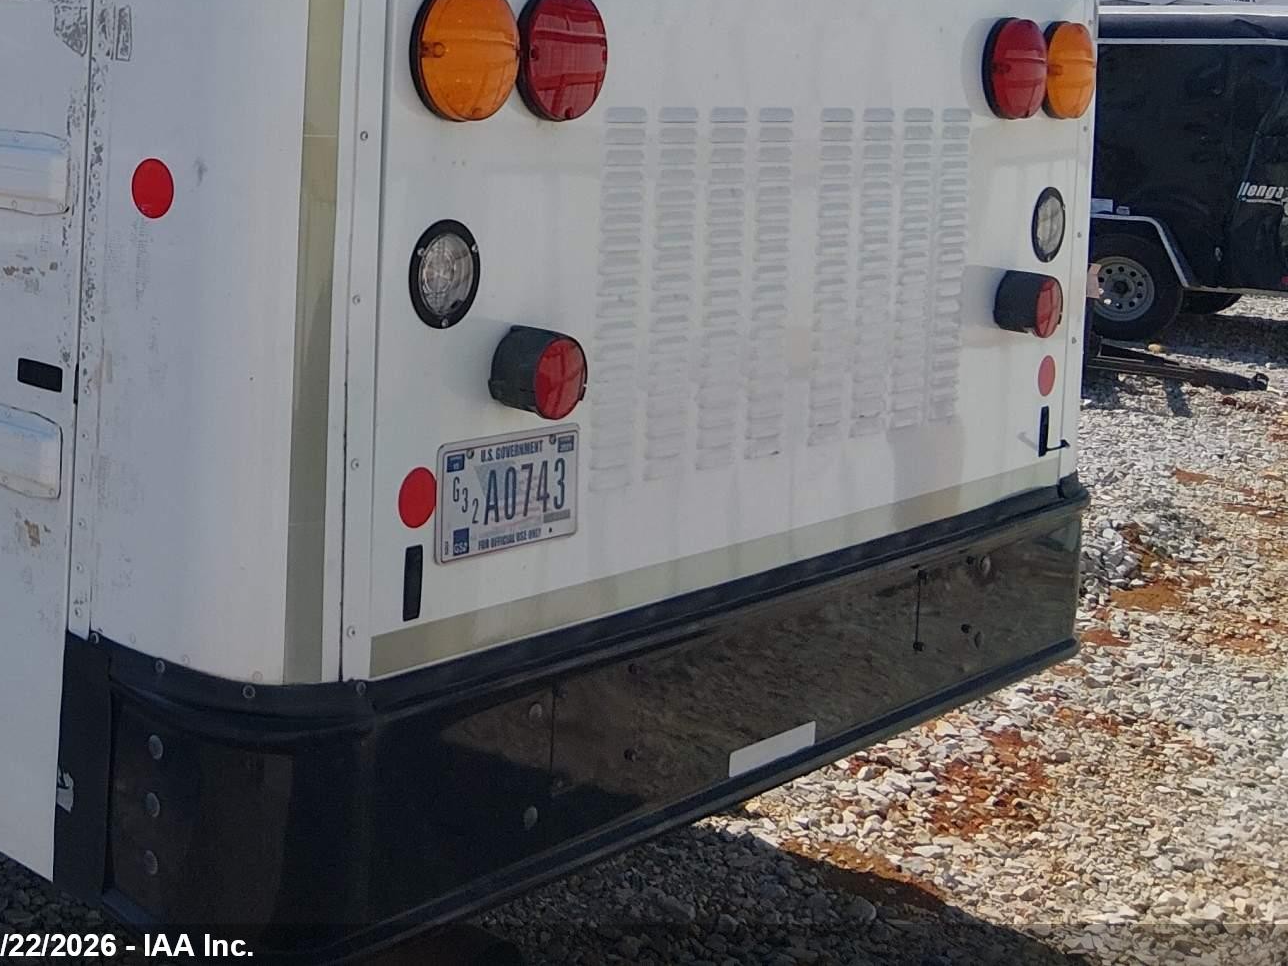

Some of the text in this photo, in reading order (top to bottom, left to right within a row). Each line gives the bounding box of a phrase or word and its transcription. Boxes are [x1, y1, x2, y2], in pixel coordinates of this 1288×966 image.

[480, 448, 493, 463] U.S.
[495, 439, 543, 460] GOVERNMENT
[483, 456, 566, 526] A0743
